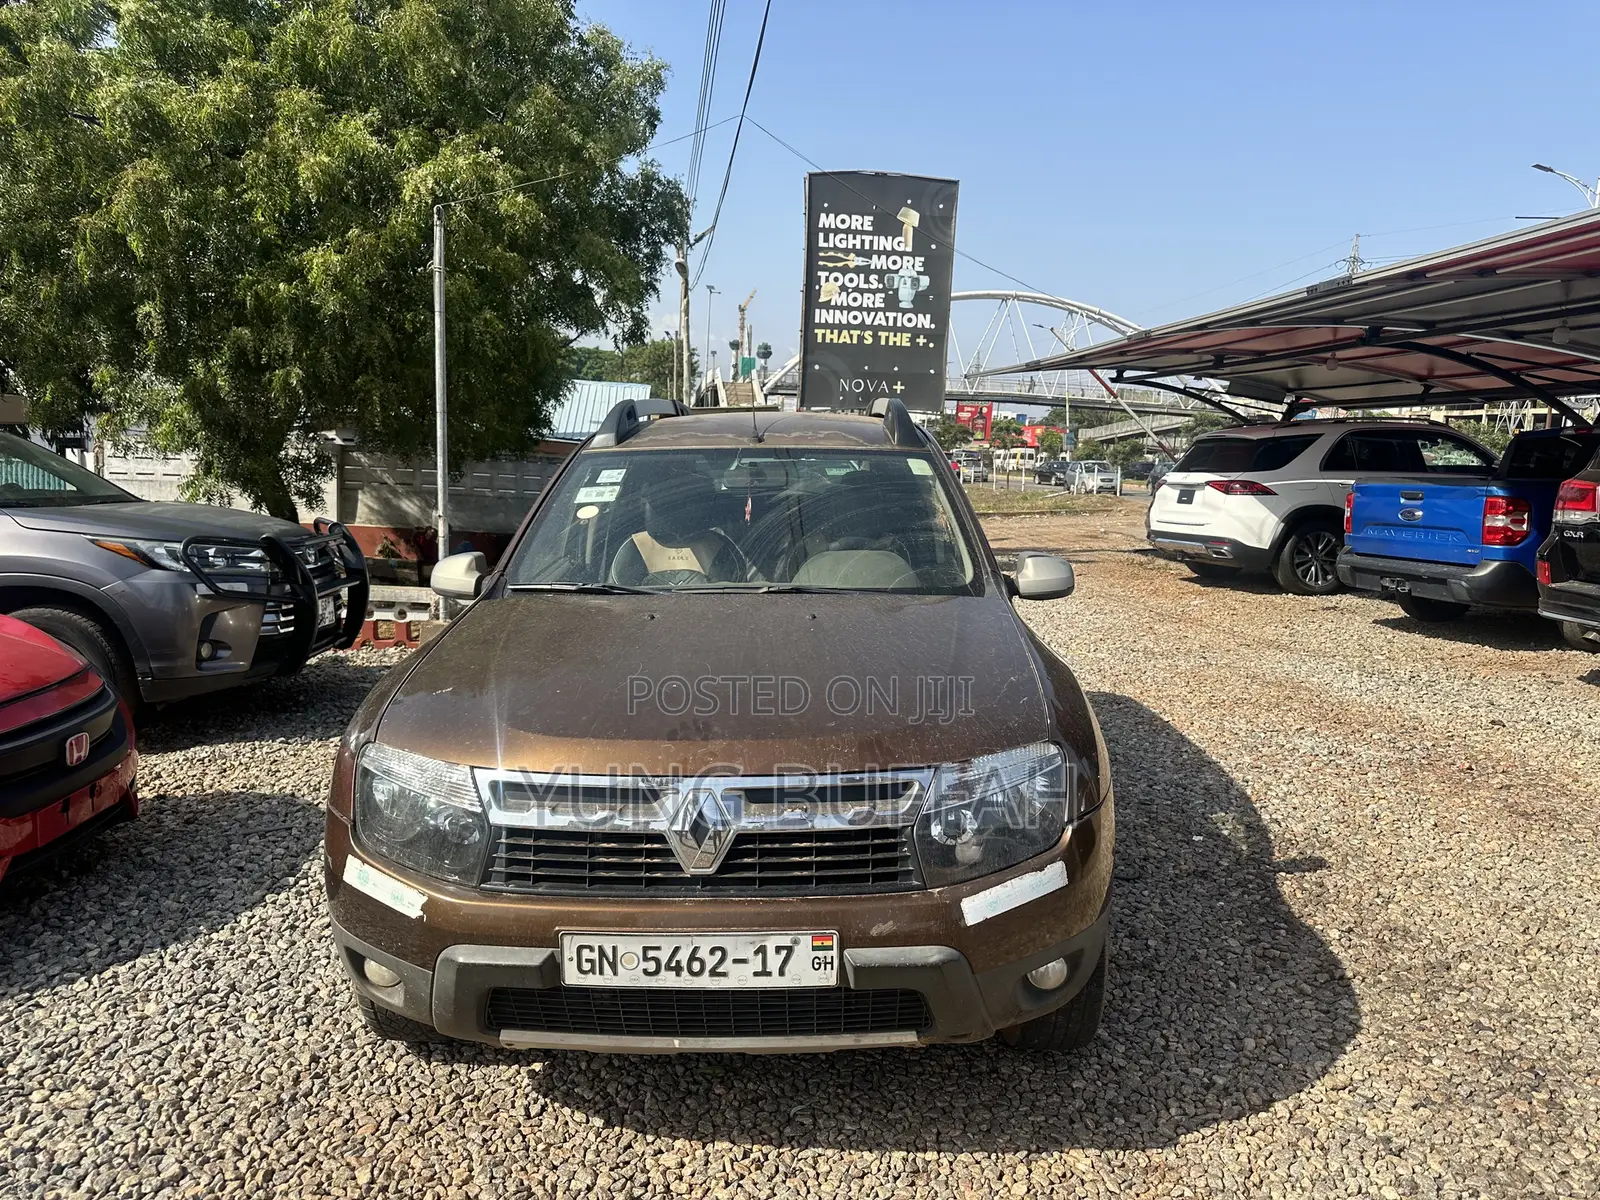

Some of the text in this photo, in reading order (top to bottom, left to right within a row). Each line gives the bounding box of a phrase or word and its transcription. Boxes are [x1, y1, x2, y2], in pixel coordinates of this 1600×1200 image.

[818, 213, 874, 231] MORE
[870, 254, 925, 272] MORE
[817, 271, 884, 289] TOOLS.
[830, 291, 885, 308] MORE
[814, 308, 936, 330] INNOVATION.
[814, 329, 873, 345] THAT'S
[878, 331, 912, 347] THE
[1366, 528, 1460, 542] MAVERICK
[1563, 529, 1584, 539] GXR
[575, 944, 796, 978] GN 5462-17
[811, 955, 835, 972] GH
